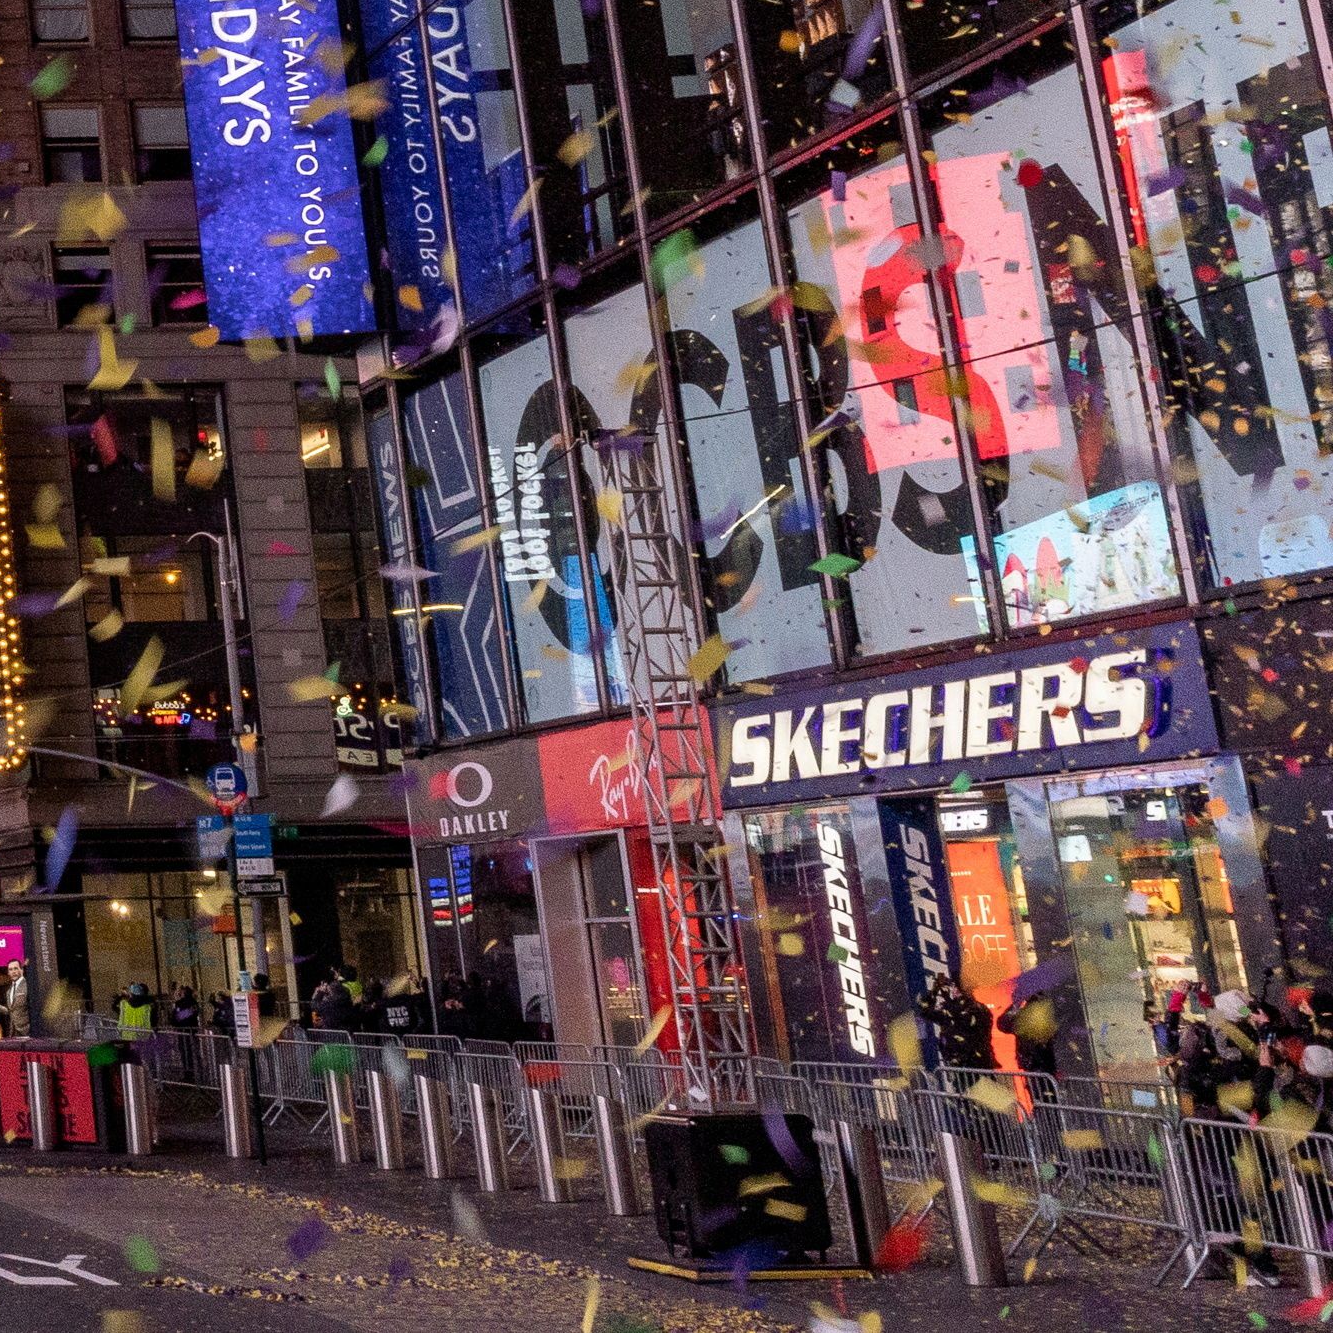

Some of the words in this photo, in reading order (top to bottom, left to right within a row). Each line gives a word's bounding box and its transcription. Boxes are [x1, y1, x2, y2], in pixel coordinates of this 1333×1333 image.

[280, 36, 314, 130] FAMIL
[292, 139, 320, 177] TO
[299, 186, 332, 289] YOUS,
[730, 649, 1149, 788] SKECHERS
[439, 810, 510, 838] OAKLEY
[816, 823, 876, 1059] SKECHERS
